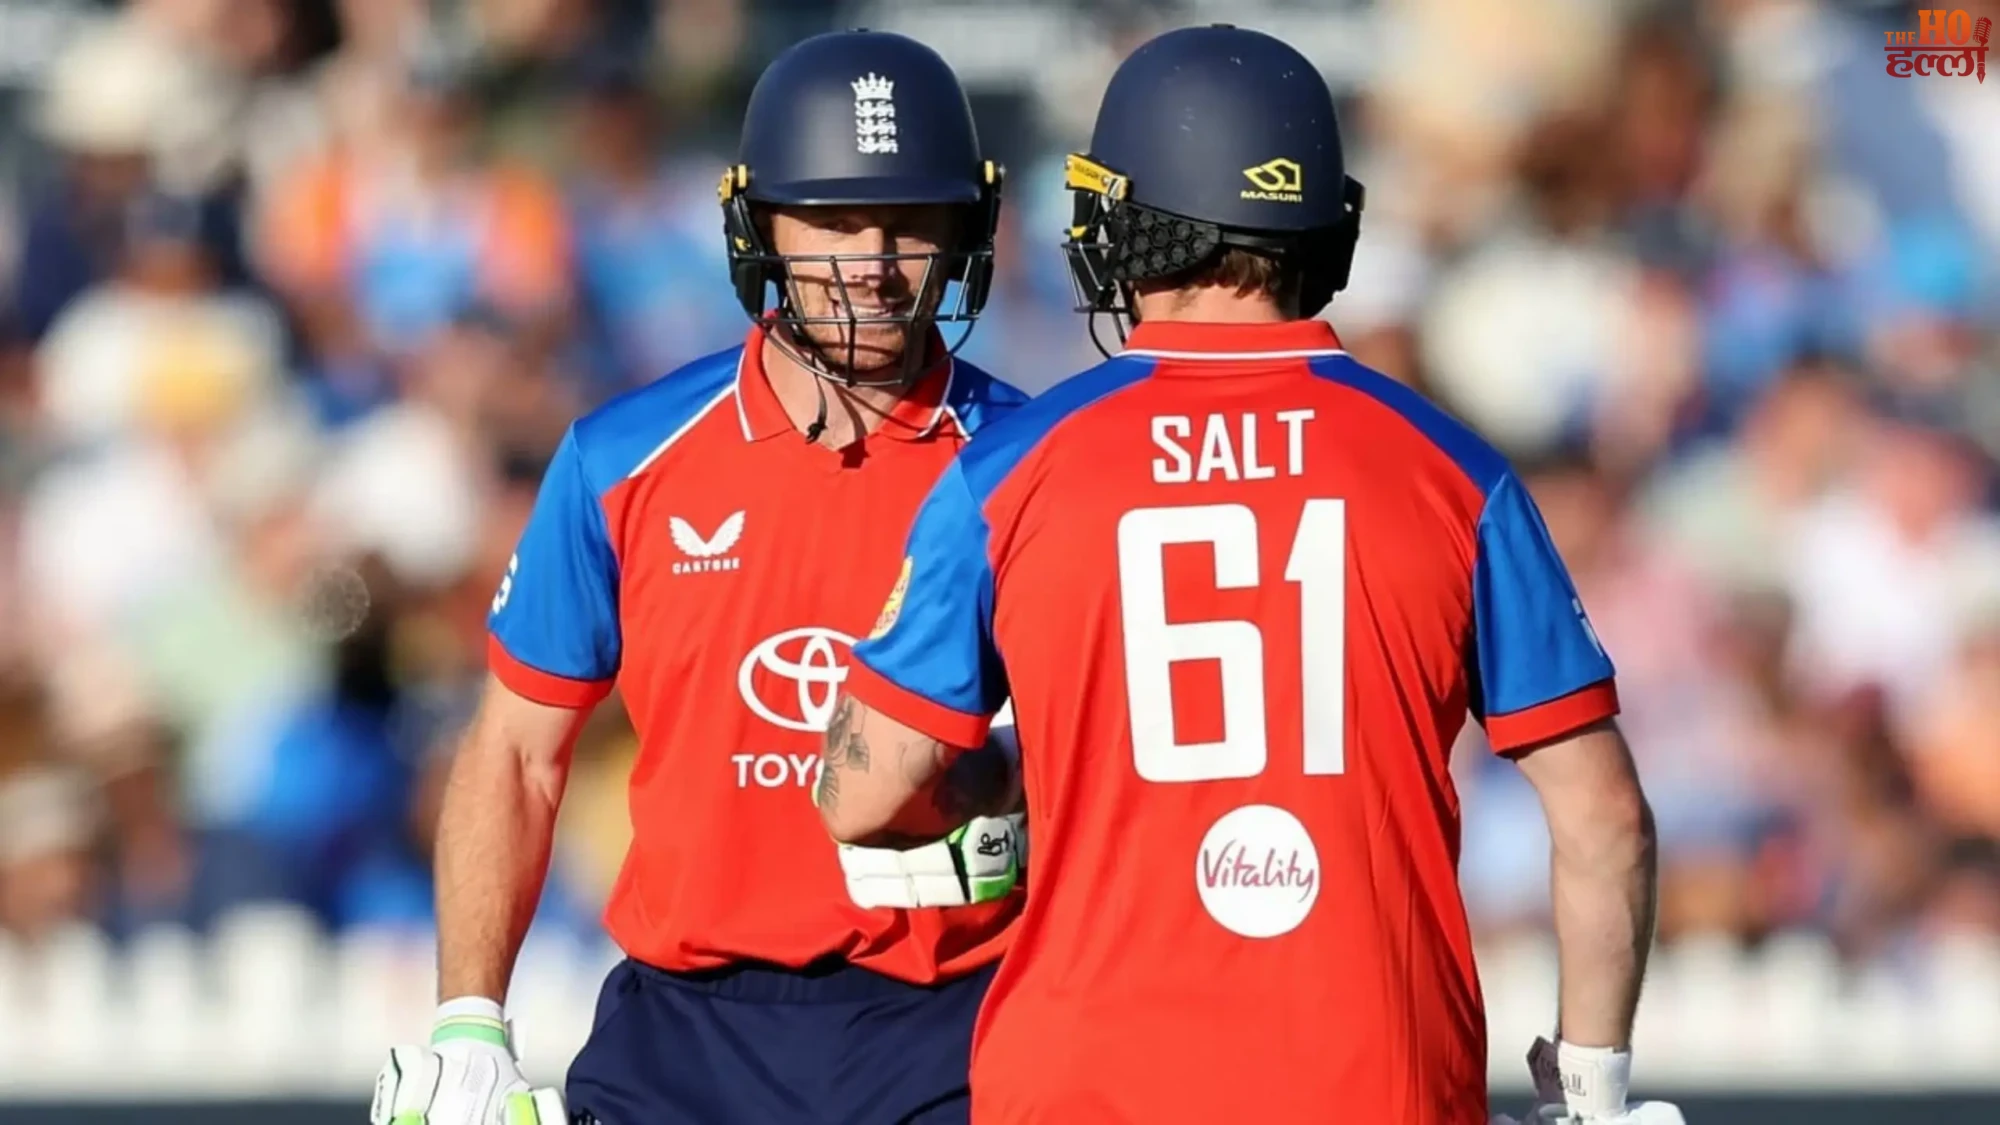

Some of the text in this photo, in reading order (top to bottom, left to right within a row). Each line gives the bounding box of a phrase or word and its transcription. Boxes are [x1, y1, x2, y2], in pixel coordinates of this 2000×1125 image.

[1240, 189, 1303, 203] MASURI
[1151, 409, 1315, 483] SALT
[672, 557, 740, 575] CASTORE
[1117, 498, 1346, 783] 61
[731, 753, 825, 788] TOY
[1203, 839, 1315, 903] Vitality
